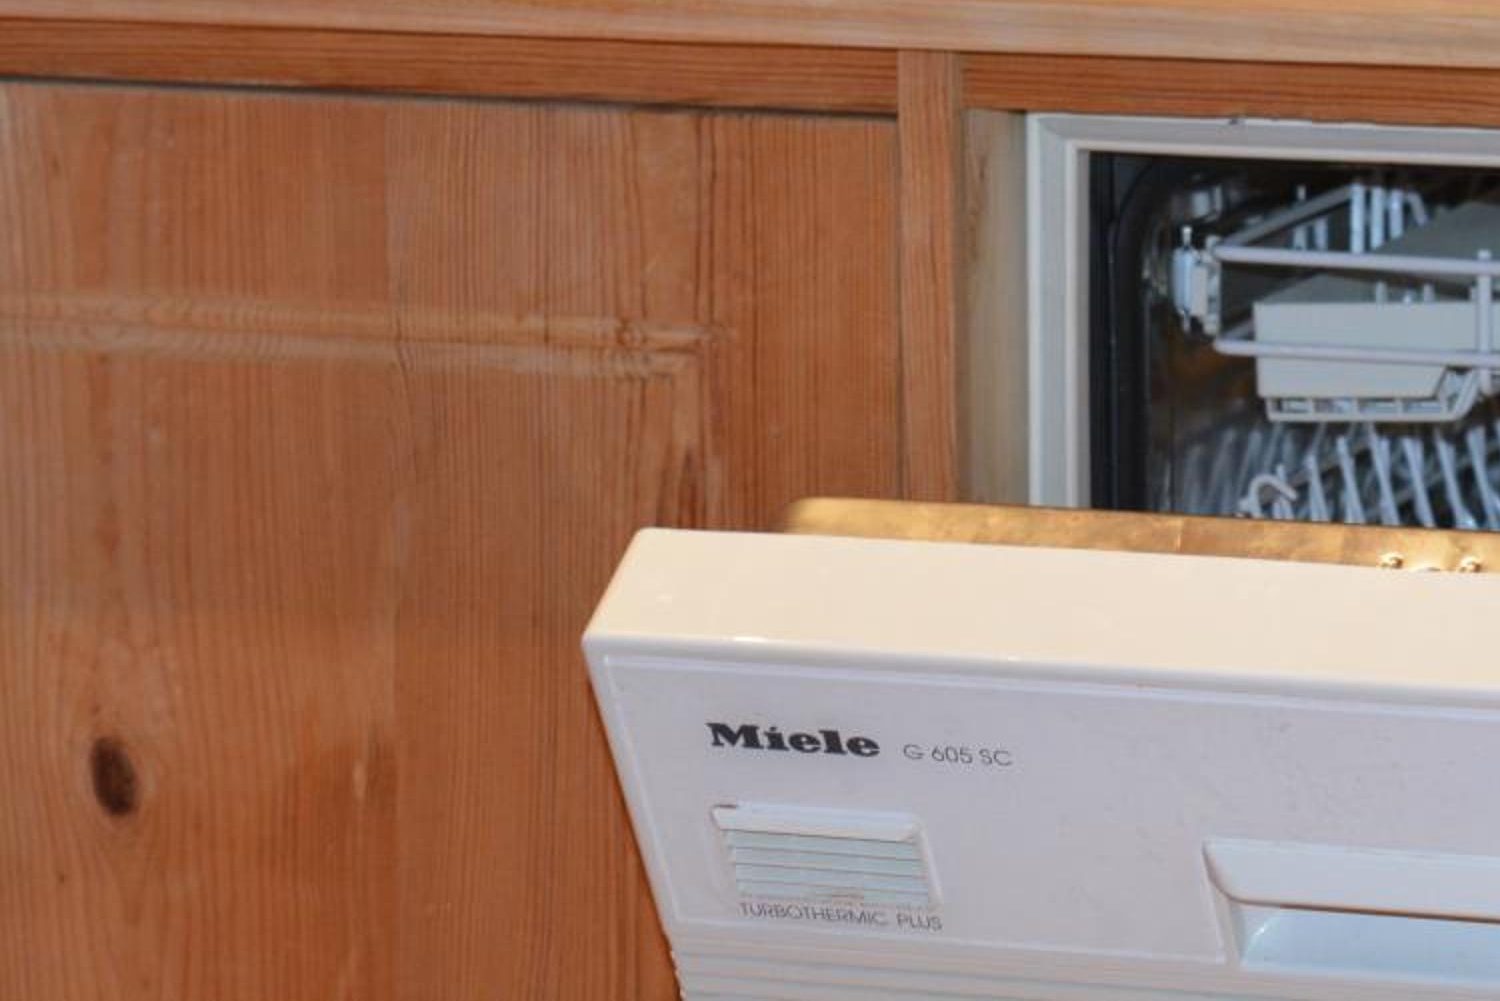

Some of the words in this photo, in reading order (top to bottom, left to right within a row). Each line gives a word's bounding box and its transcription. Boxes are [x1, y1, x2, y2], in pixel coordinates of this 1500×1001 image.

[706, 722, 880, 757] Miele
[903, 744, 925, 760] G
[931, 745, 973, 764] 605
[980, 748, 1013, 766] SC
[739, 902, 888, 926] TURBOTHERMIC
[896, 913, 942, 931] PLUS
